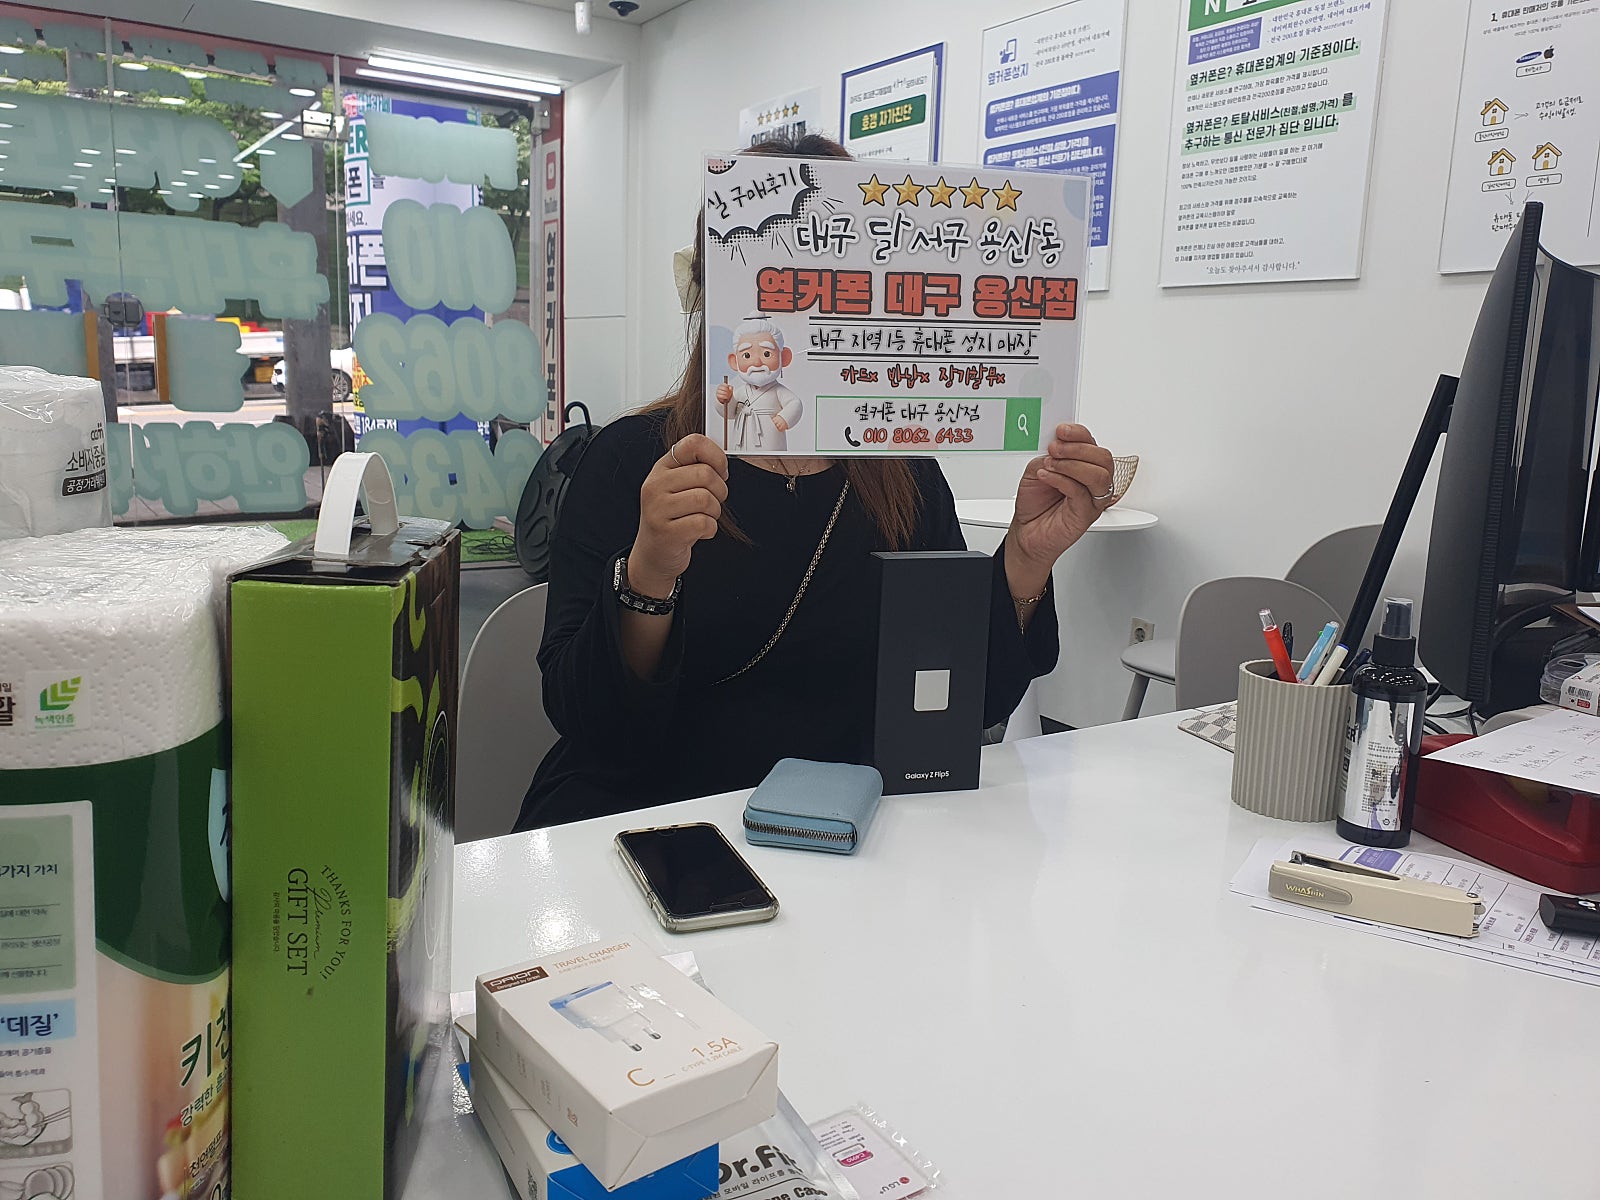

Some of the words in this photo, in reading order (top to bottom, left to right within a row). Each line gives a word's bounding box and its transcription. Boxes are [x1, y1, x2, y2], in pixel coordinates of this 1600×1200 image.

[1189, 64, 1231, 86] 옆커폰은?
[1234, 50, 1295, 76] 휴대폰업계의
[1299, 35, 1359, 62] 기준점이다.
[879, 104, 912, 126] 자가진단
[1186, 115, 1227, 134] 옆커폰은?
[1184, 133, 1220, 150] 추구하는
[1224, 129, 1242, 144] 통신
[1245, 124, 1276, 140] 전문가
[1279, 120, 1299, 135] 집단
[1303, 112, 1340, 131] 입니다.
[706, 190, 730, 220] 실
[730, 166, 799, 206] 구매후기
[797, 213, 857, 254] 대구
[978, 219, 1064, 266] 용산동
[757, 266, 872, 315] 옆커폰
[884, 271, 962, 317] 대구
[973, 275, 1078, 320] 용산점
[811, 329, 845, 352] 대구
[851, 329, 883, 352] 지역
[887, 332, 905, 352] 1등
[912, 328, 956, 355] 휴대폰
[961, 330, 992, 353] 성지
[997, 332, 1038, 356] 매장
[853, 404, 897, 422] 옆커폰
[900, 403, 930, 421] 대구
[933, 404, 981, 423] 용산점
[862, 426, 888, 443] 010
[892, 426, 930, 444] 8062
[935, 426, 974, 444] 6433
[905, 772, 930, 780] Galaxy
[934, 770, 950, 779] Flip5
[287, 867, 309, 926] GIFT
[321, 864, 351, 916] THANKS
[306, 884, 332, 961] Premium
[338, 920, 352, 946] FOR
[287, 932, 309, 976] SET
[319, 949, 346, 980] YOU!
[552, 955, 589, 970] TRAVEL
[588, 942, 632, 959] CHARGER
[490, 967, 541, 987] ORION
[691, 1037, 738, 1058] 1.5A
[627, 1067, 656, 1087] C
[724, 1182, 750, 1195] 모바일
[751, 1169, 786, 1186] 라이프를
